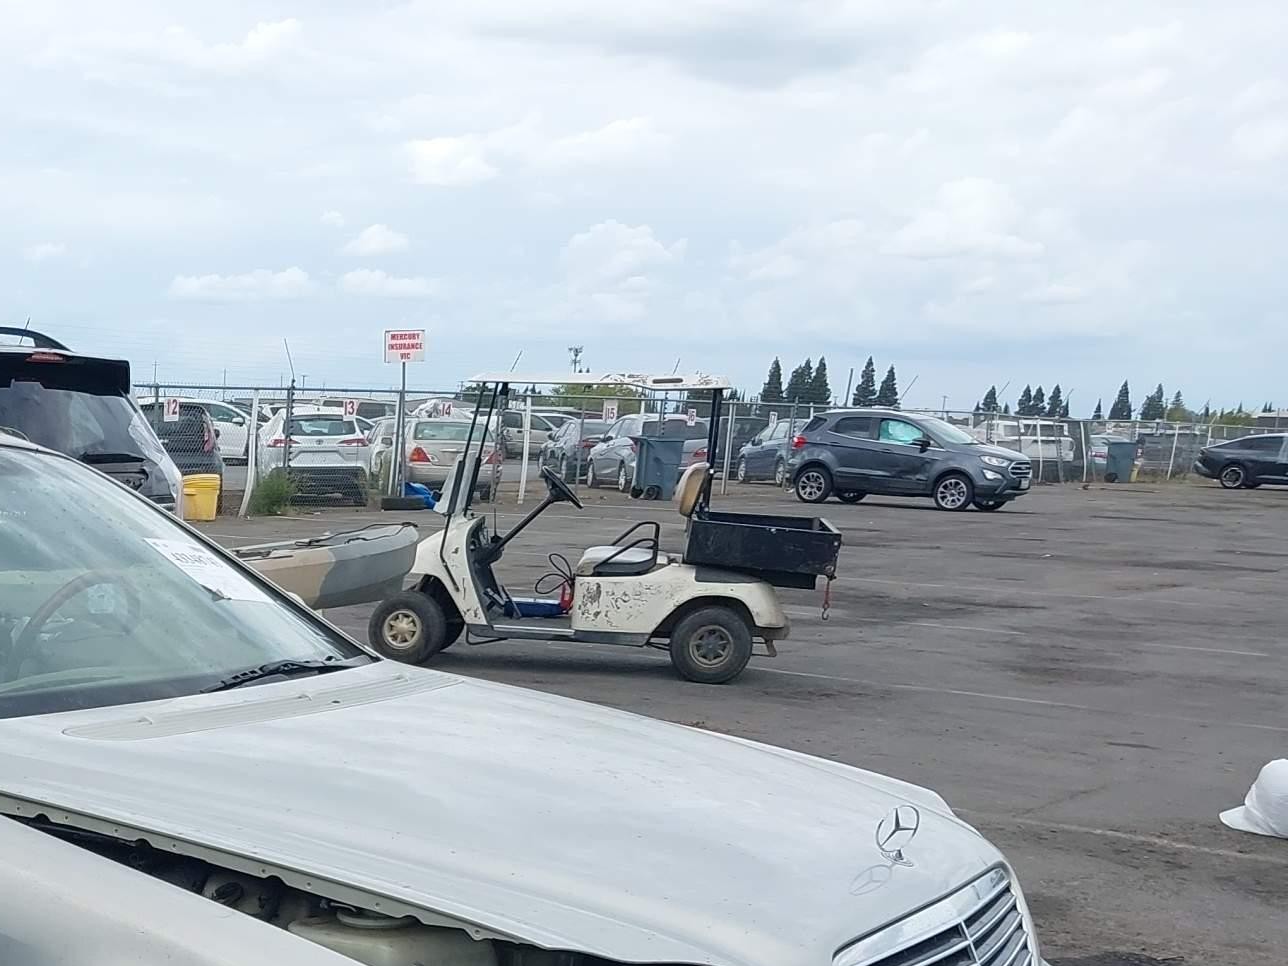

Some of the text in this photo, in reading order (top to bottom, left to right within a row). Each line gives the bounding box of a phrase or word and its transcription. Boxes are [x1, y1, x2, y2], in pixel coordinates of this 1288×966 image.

[390, 333, 420, 341] MERCURY
[388, 342, 423, 351] INSURANCE
[400, 352, 411, 360] VIC
[167, 398, 178, 415] 12
[344, 400, 355, 416] 13
[442, 403, 452, 417] 14
